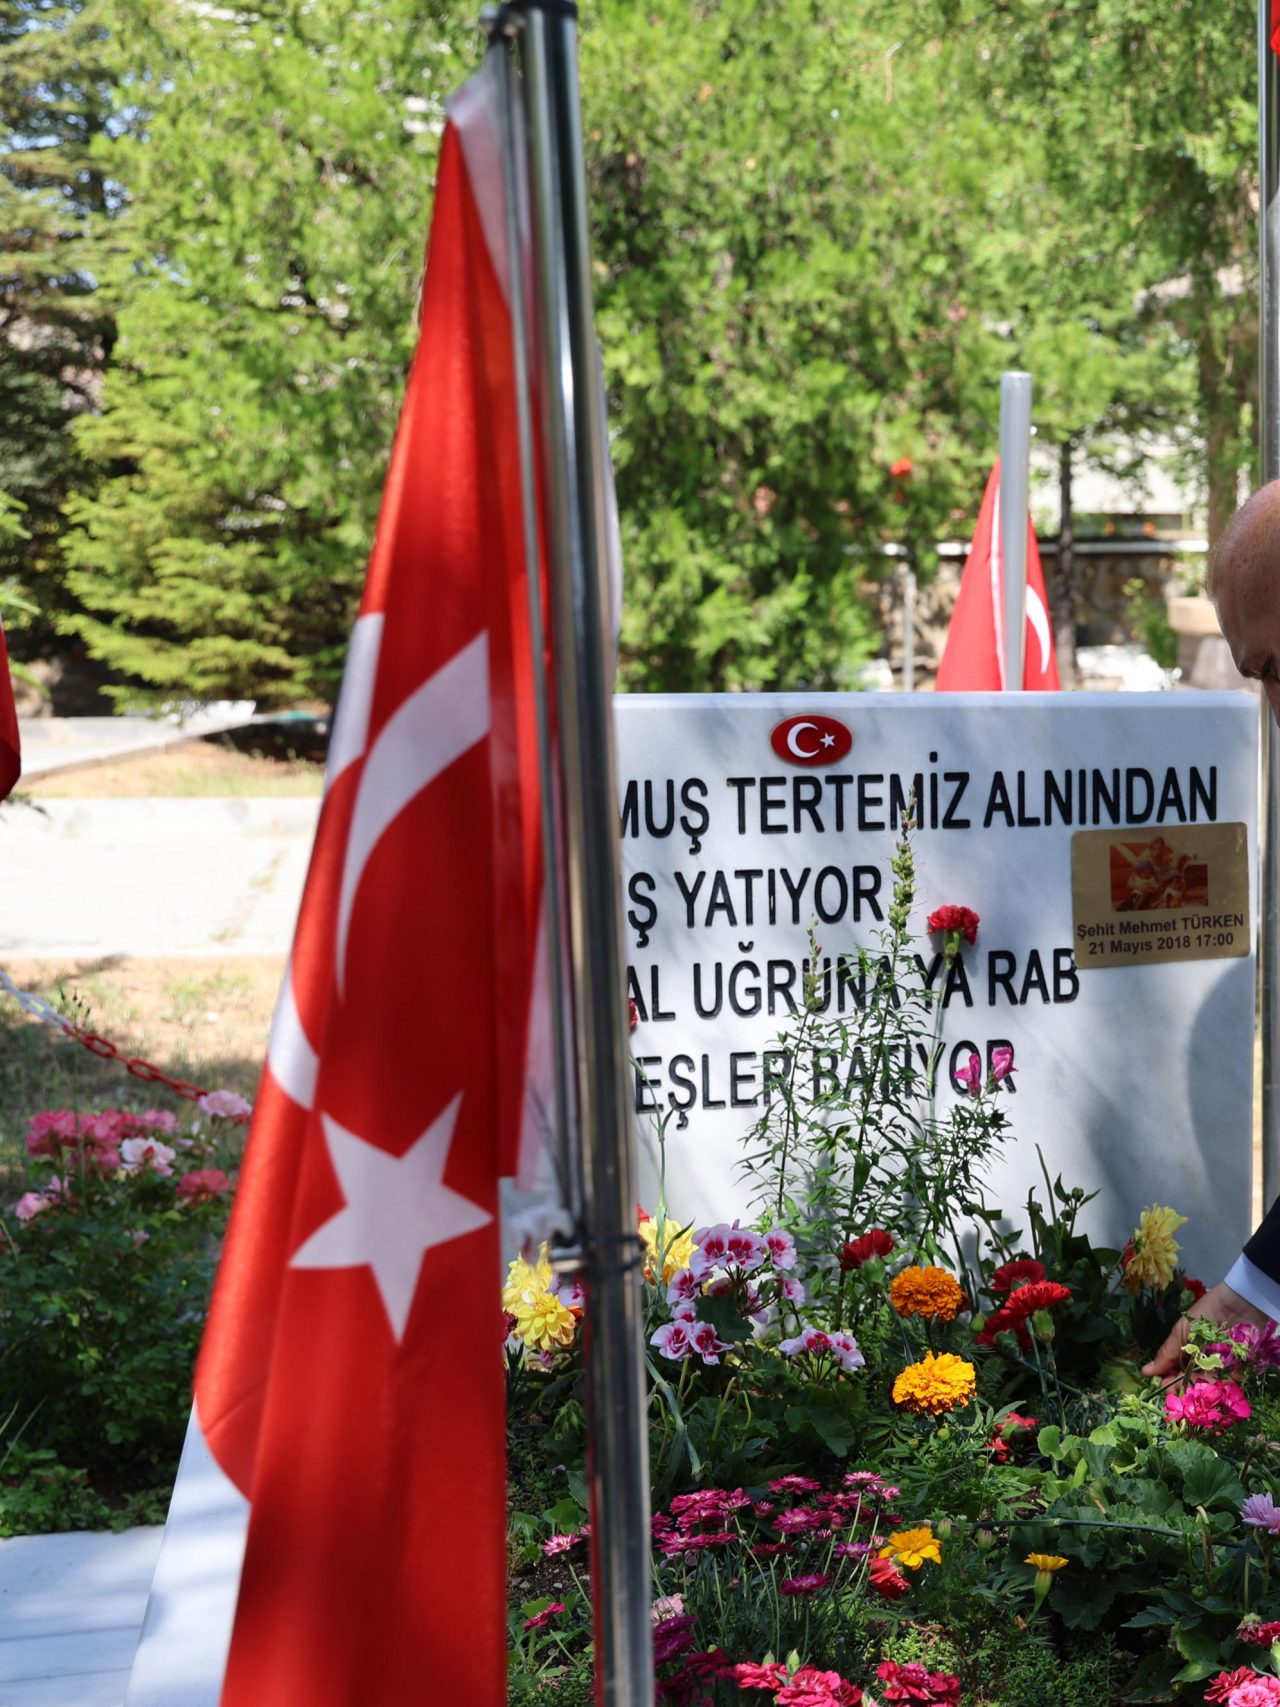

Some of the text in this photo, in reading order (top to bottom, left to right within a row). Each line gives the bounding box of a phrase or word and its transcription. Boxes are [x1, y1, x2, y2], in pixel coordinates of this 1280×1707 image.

[726, 750, 970, 834] TERTEMİZ
[984, 766, 1217, 829] ALNINDAN
[674, 864, 884, 928] YATIYOR
[1076, 914, 1244, 941] Şehit Mehmet TÜRKEN
[1088, 932, 1234, 956] 21 Mayıs 2018 17:00
[693, 941, 901, 1020] UĞRUNA
[913, 949, 974, 1009] YA
[988, 947, 1080, 1007] RAB
